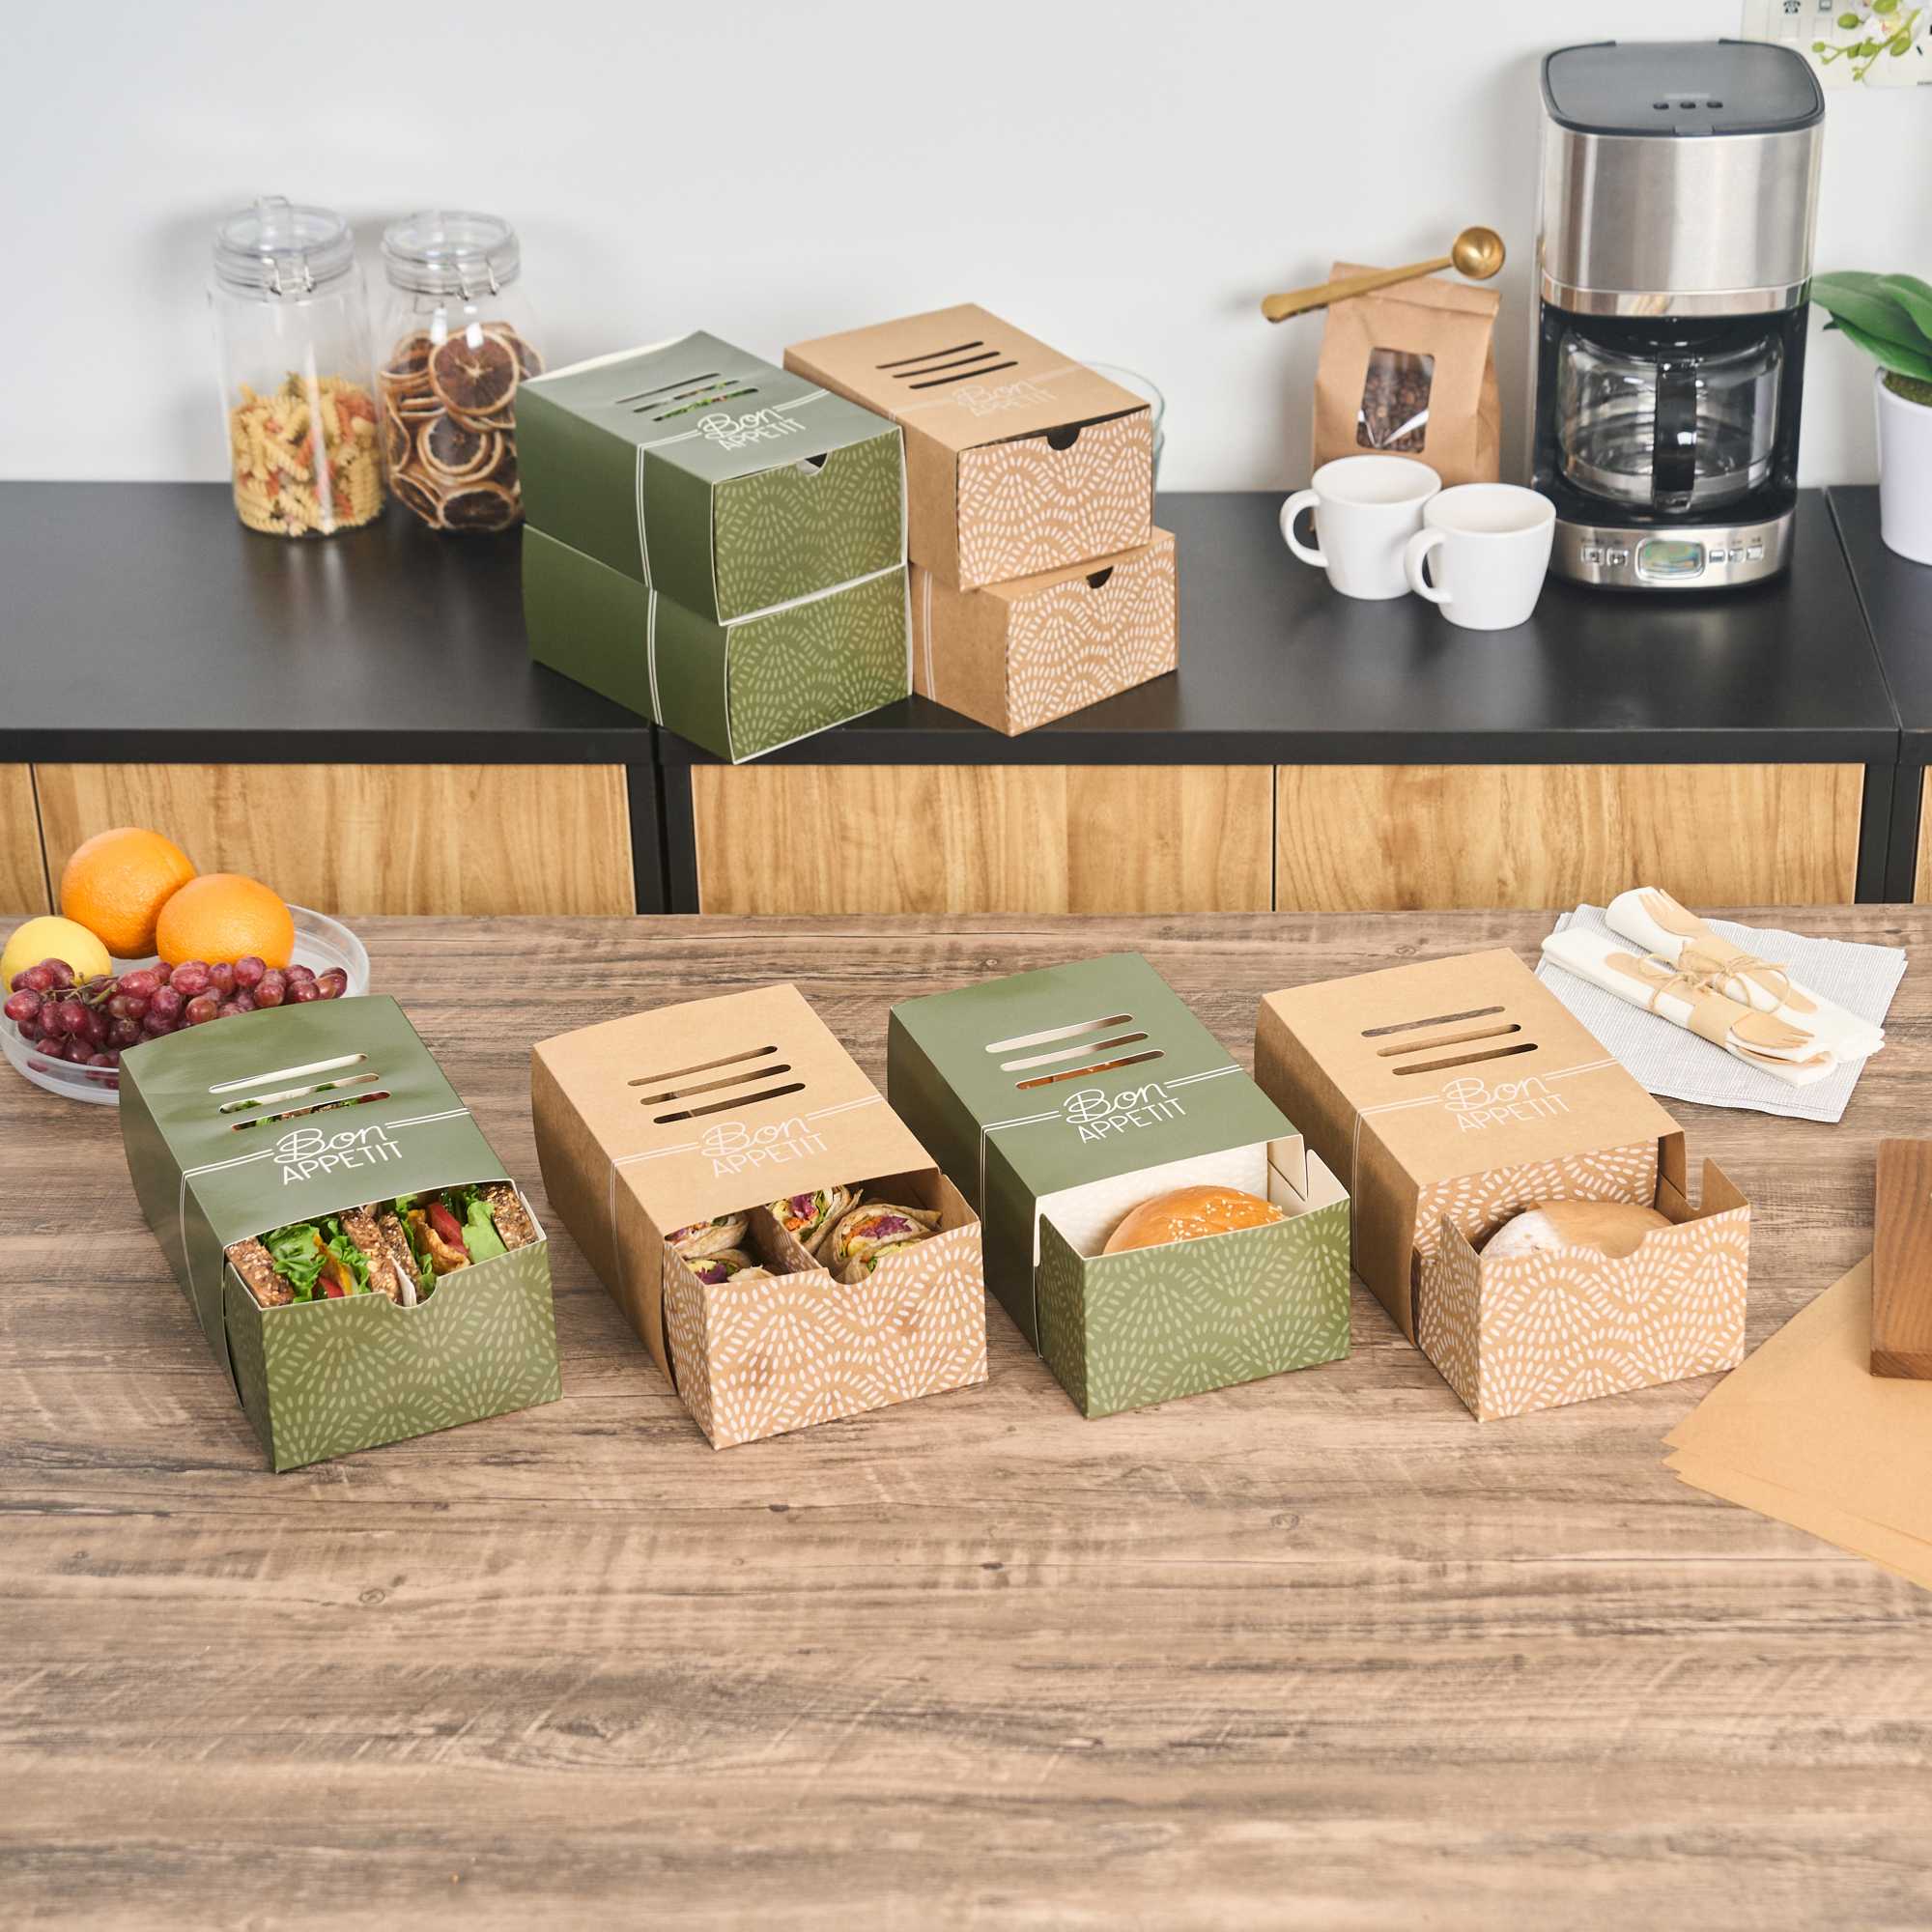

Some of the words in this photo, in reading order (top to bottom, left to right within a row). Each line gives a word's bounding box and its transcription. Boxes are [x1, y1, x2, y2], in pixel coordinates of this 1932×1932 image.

[697, 409, 783, 439] Bon
[719, 418, 806, 451] APPETIT
[1064, 1083, 1168, 1123] Bon
[1442, 1077, 1550, 1111] Bon
[1456, 1094, 1570, 1133] APPETIT
[701, 1117, 810, 1157] Bon
[1078, 1097, 1186, 1144] APPETIT
[273, 1125, 387, 1163] Bon
[282, 1140, 403, 1185] APPETIT
[712, 1132, 828, 1179] APPETIT
